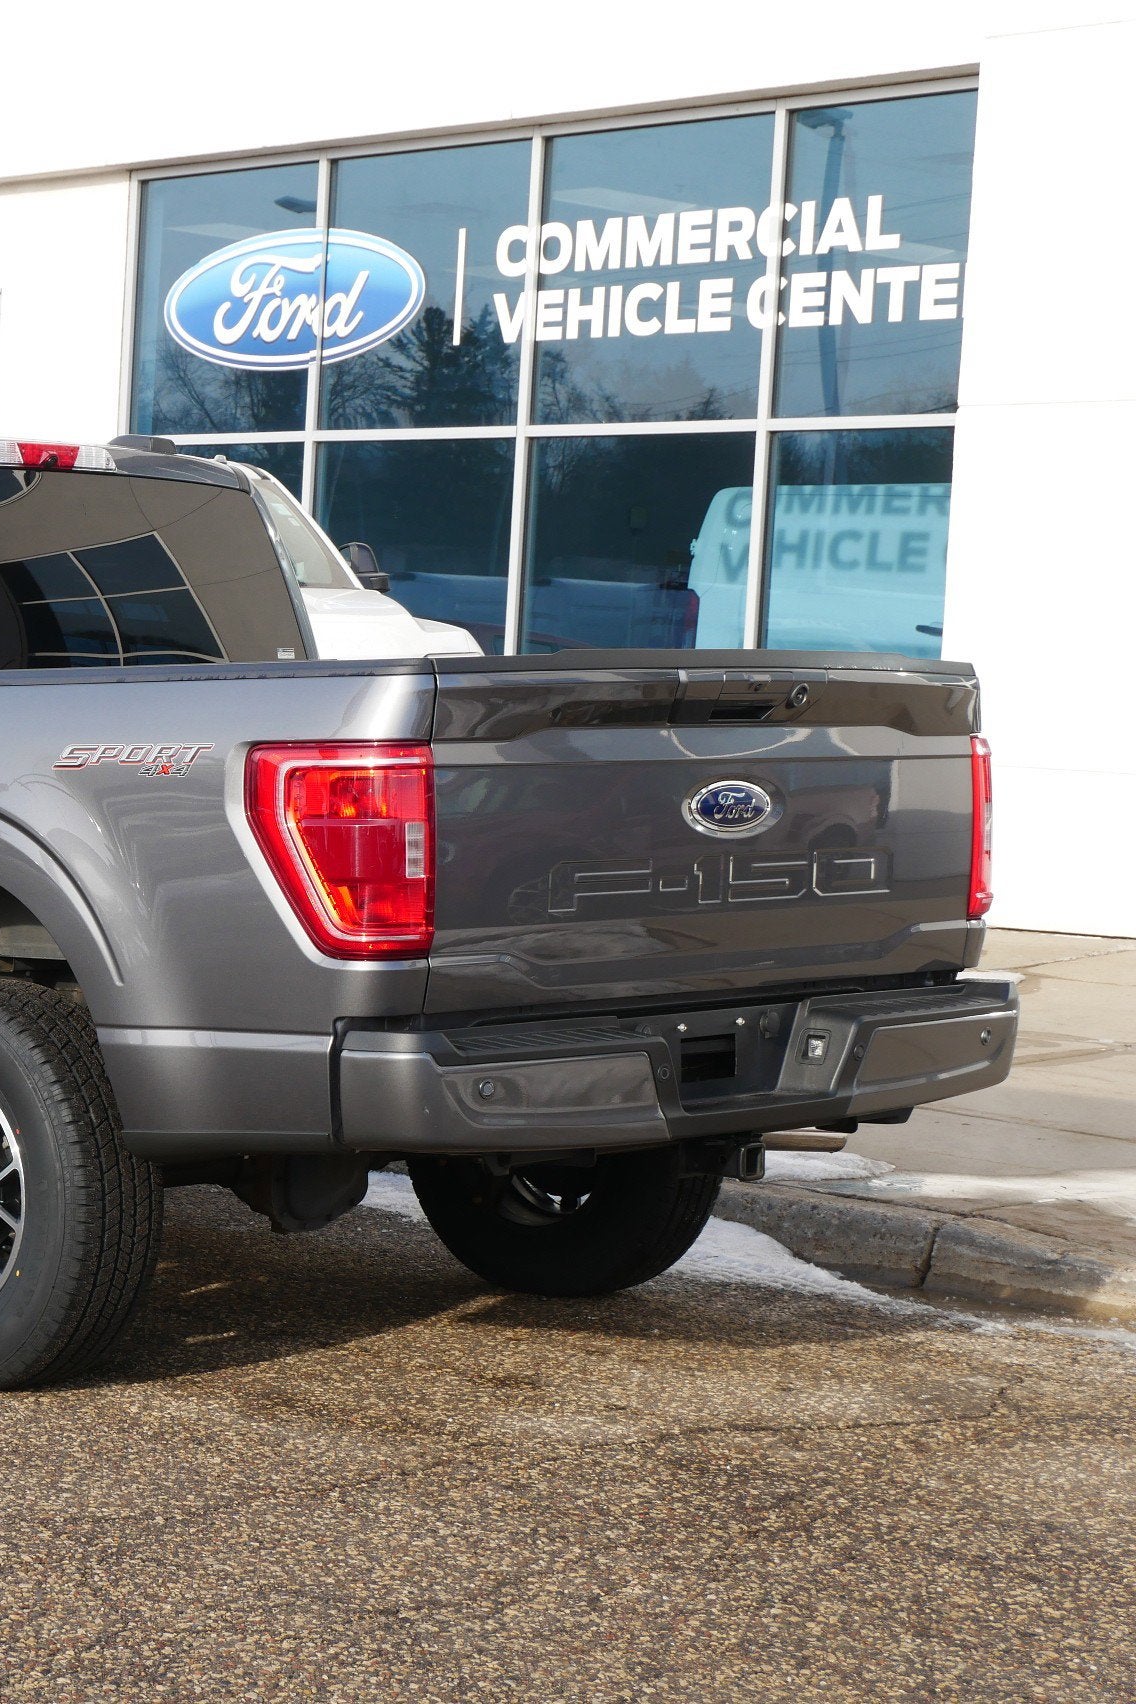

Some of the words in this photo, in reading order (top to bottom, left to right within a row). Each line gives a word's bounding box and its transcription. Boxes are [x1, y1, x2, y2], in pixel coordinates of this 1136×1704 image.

[495, 194, 901, 277] COMMERCIAL
[213, 253, 369, 345] Ford
[493, 277, 734, 343] VEHICLE
[746, 261, 967, 329] CENTE
[721, 529, 931, 583] VHICLE
[52, 743, 216, 770] SPORT
[713, 791, 756, 819] Ford
[548, 847, 894, 912] F-150
